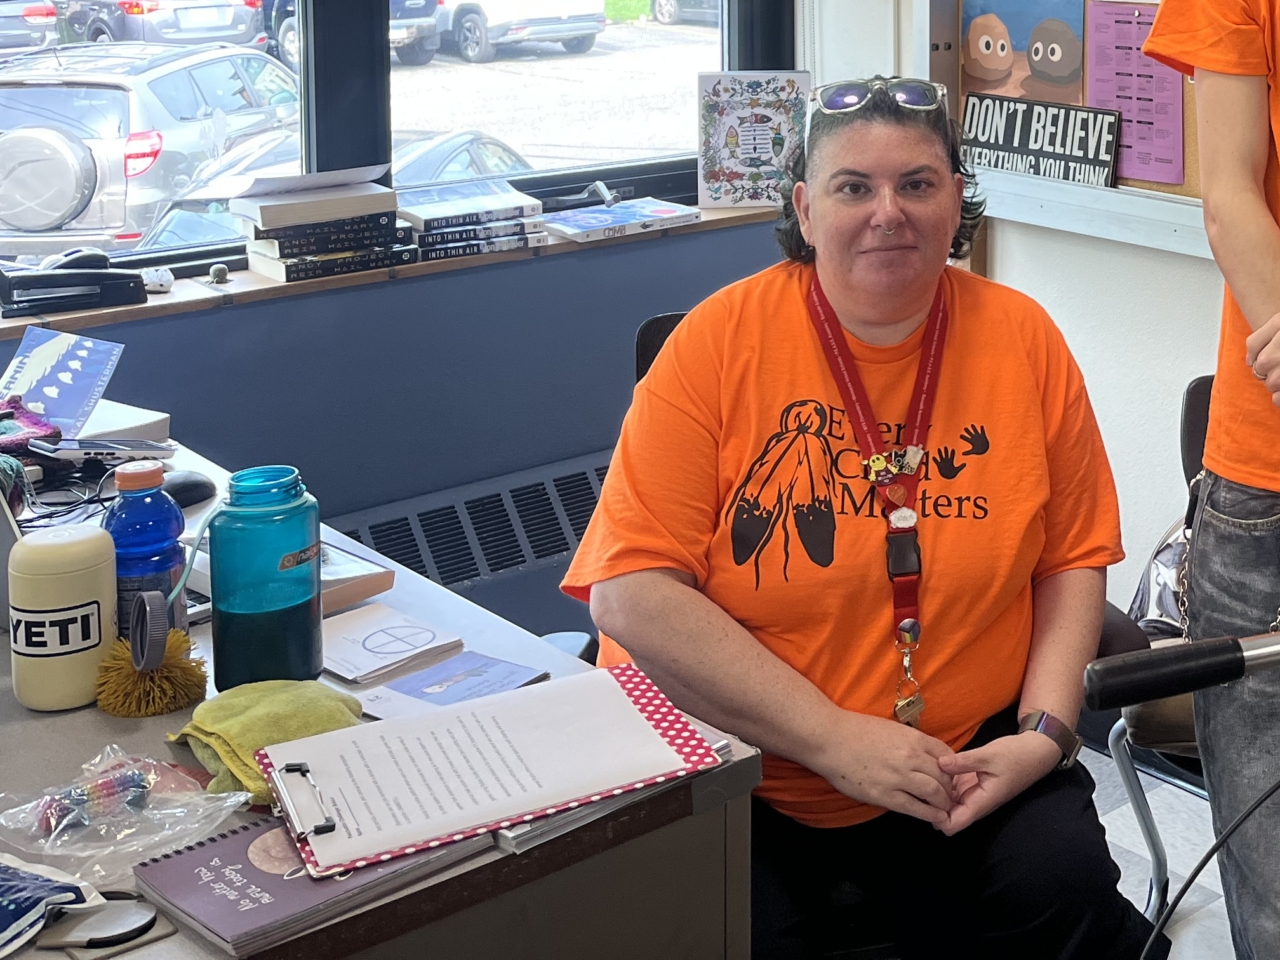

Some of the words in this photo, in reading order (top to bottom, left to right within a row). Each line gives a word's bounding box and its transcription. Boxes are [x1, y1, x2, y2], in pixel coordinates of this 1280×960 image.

[963, 96, 1028, 147] DON'T
[1028, 105, 1115, 162] BELIEVE
[960, 145, 1035, 174] EVERYTHING
[1039, 157, 1065, 179] YOU
[1068, 161, 1109, 187] THINK
[431, 219, 446, 228] INTO
[448, 216, 463, 226] THIN
[465, 214, 477, 223] AIR
[331, 229, 386, 240] PROJECT
[425, 235, 441, 243] INTO
[444, 232, 460, 241] THIN
[462, 230, 475, 239] AIR
[328, 241, 357, 249] HAIL
[428, 249, 444, 258] INTO
[447, 246, 463, 256] THIN
[466, 245, 478, 254] AIR
[334, 264, 363, 273] HAIL
[369, 259, 397, 267] MARY
[337, 252, 392, 264] PROJECT
[85, 347, 120, 412] SHUSTERMAN
[10, 613, 91, 648] YETI
[221, 864, 248, 887] today
[211, 878, 242, 902] matter
[245, 883, 275, 905] AWFUL
